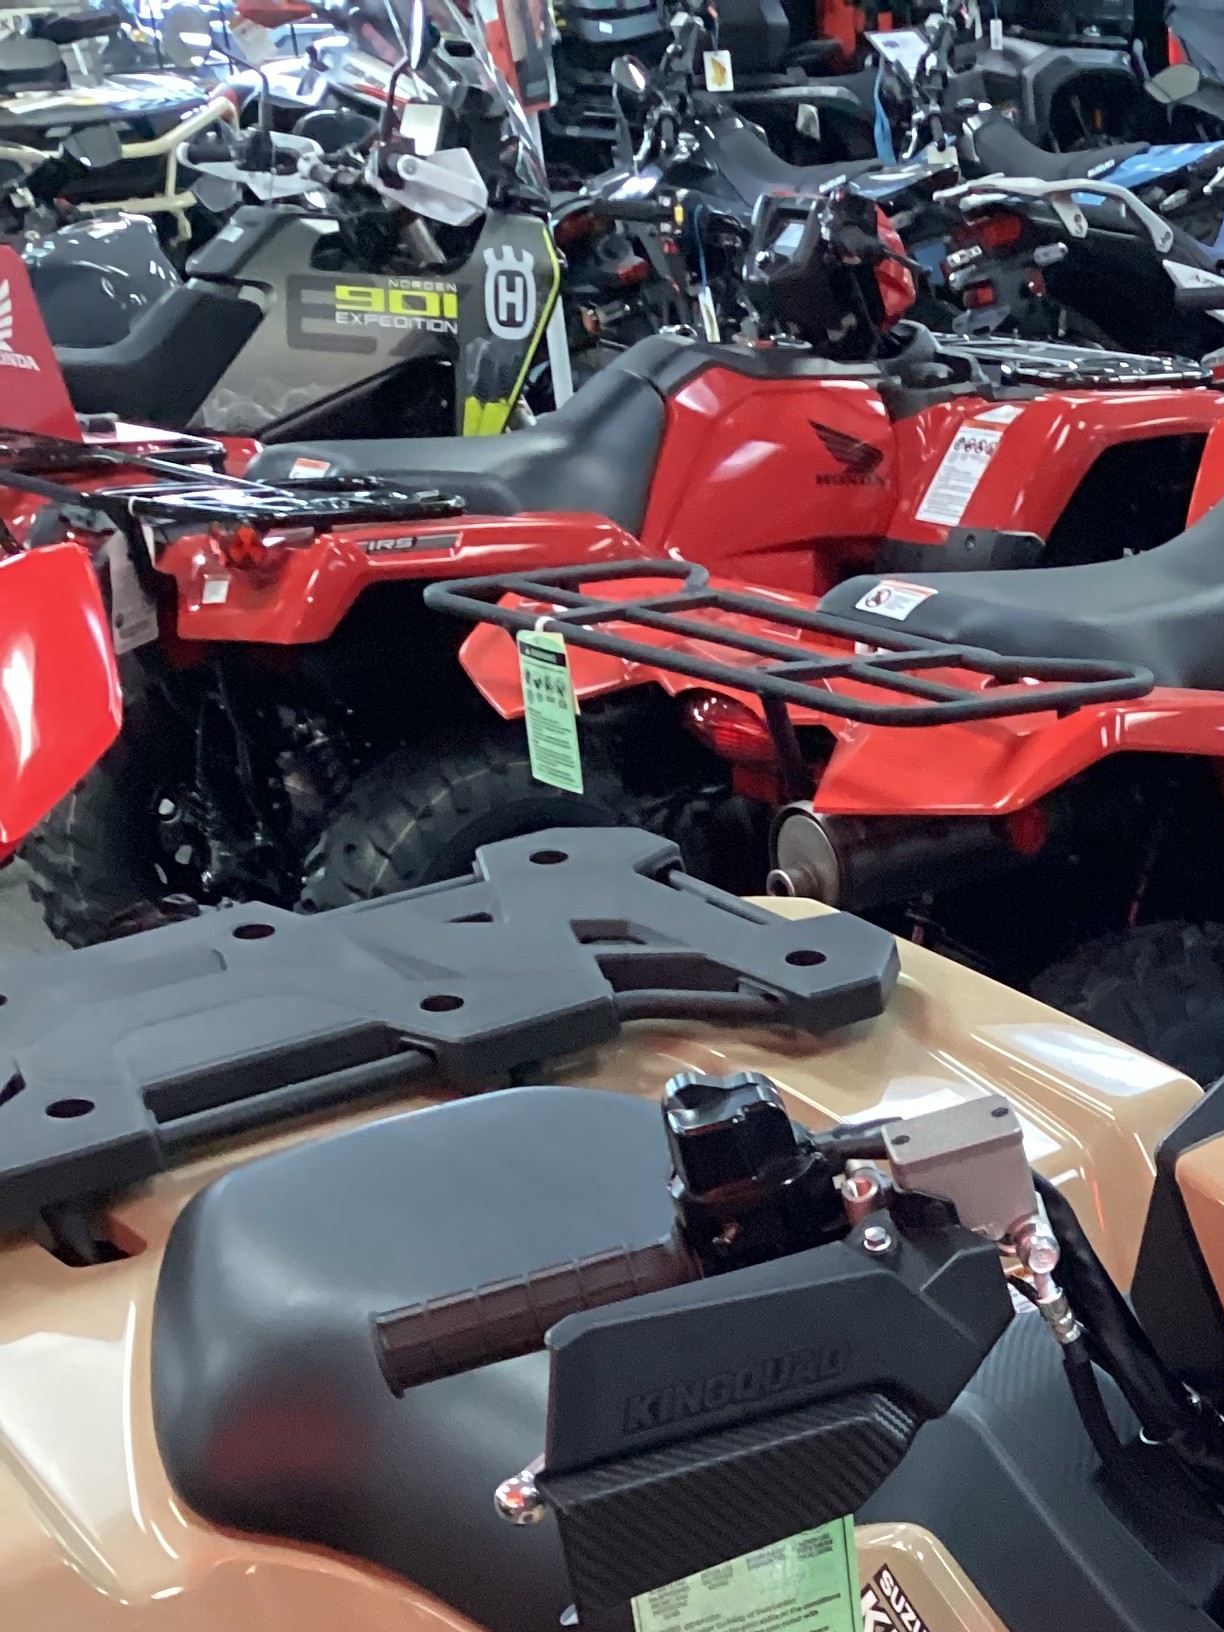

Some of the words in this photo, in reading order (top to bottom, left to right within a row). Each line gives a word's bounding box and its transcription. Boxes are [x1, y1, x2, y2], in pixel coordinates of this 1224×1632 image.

[335, 284, 458, 319] 901
[335, 311, 458, 335] EXPEDITION
[815, 473, 888, 487] HONDA
[368, 537, 415, 551] IRS
